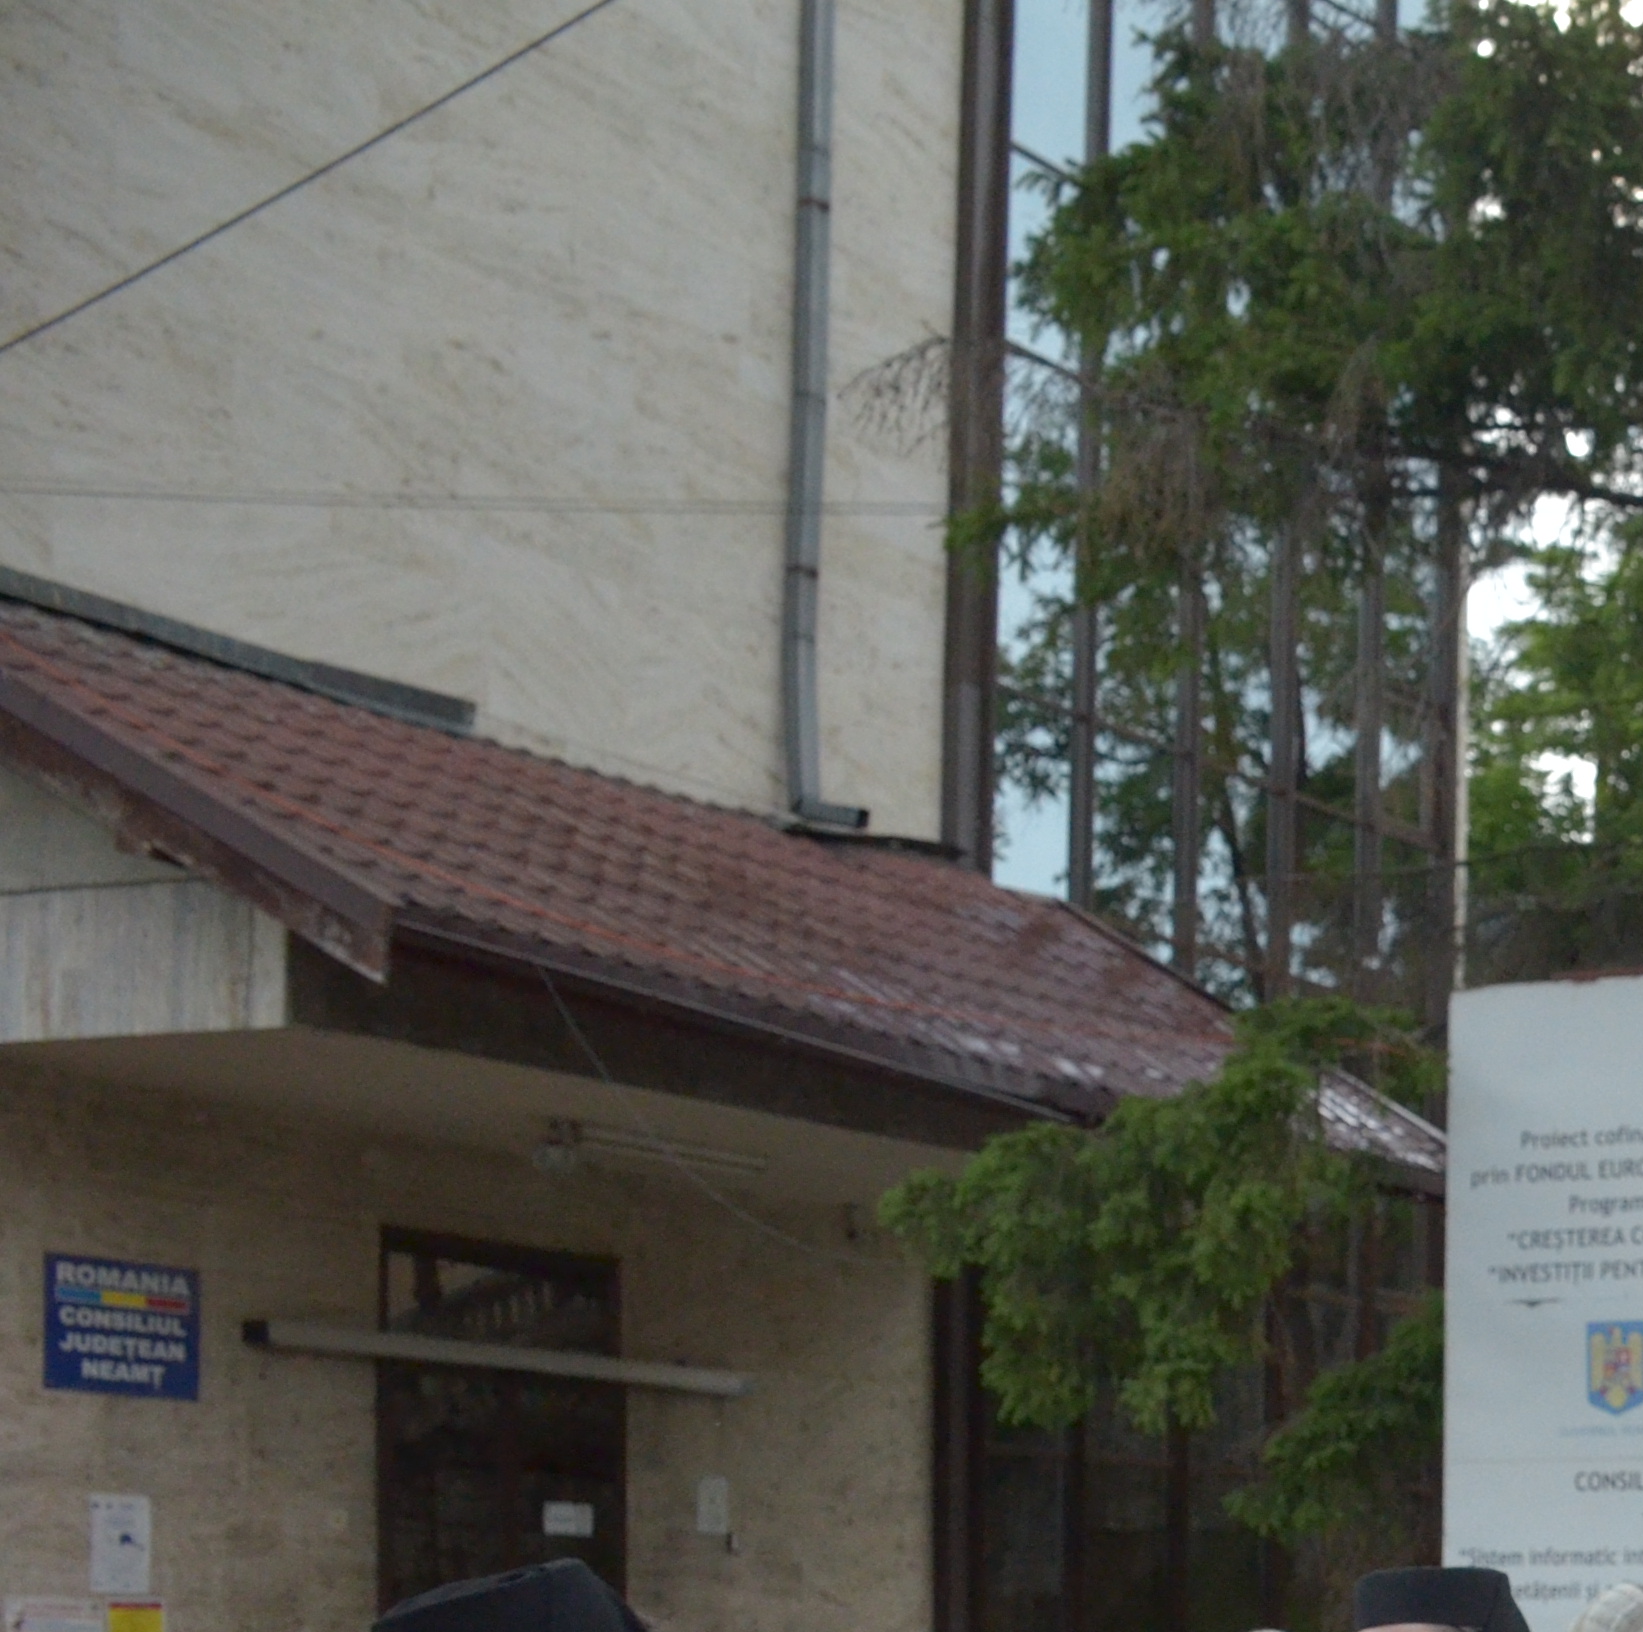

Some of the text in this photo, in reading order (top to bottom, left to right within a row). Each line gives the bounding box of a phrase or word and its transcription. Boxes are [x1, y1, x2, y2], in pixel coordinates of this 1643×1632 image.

[1520, 1129, 1588, 1149] Proiect
[1470, 1167, 1510, 1190] prin
[1514, 1161, 1593, 1184] FONDUL
[58, 1304, 188, 1338] CONSILIUL
[58, 1331, 188, 1363] JUDEȚEAN
[81, 1357, 167, 1389] NEAMȚ
[1529, 1546, 1616, 1567] informatic
